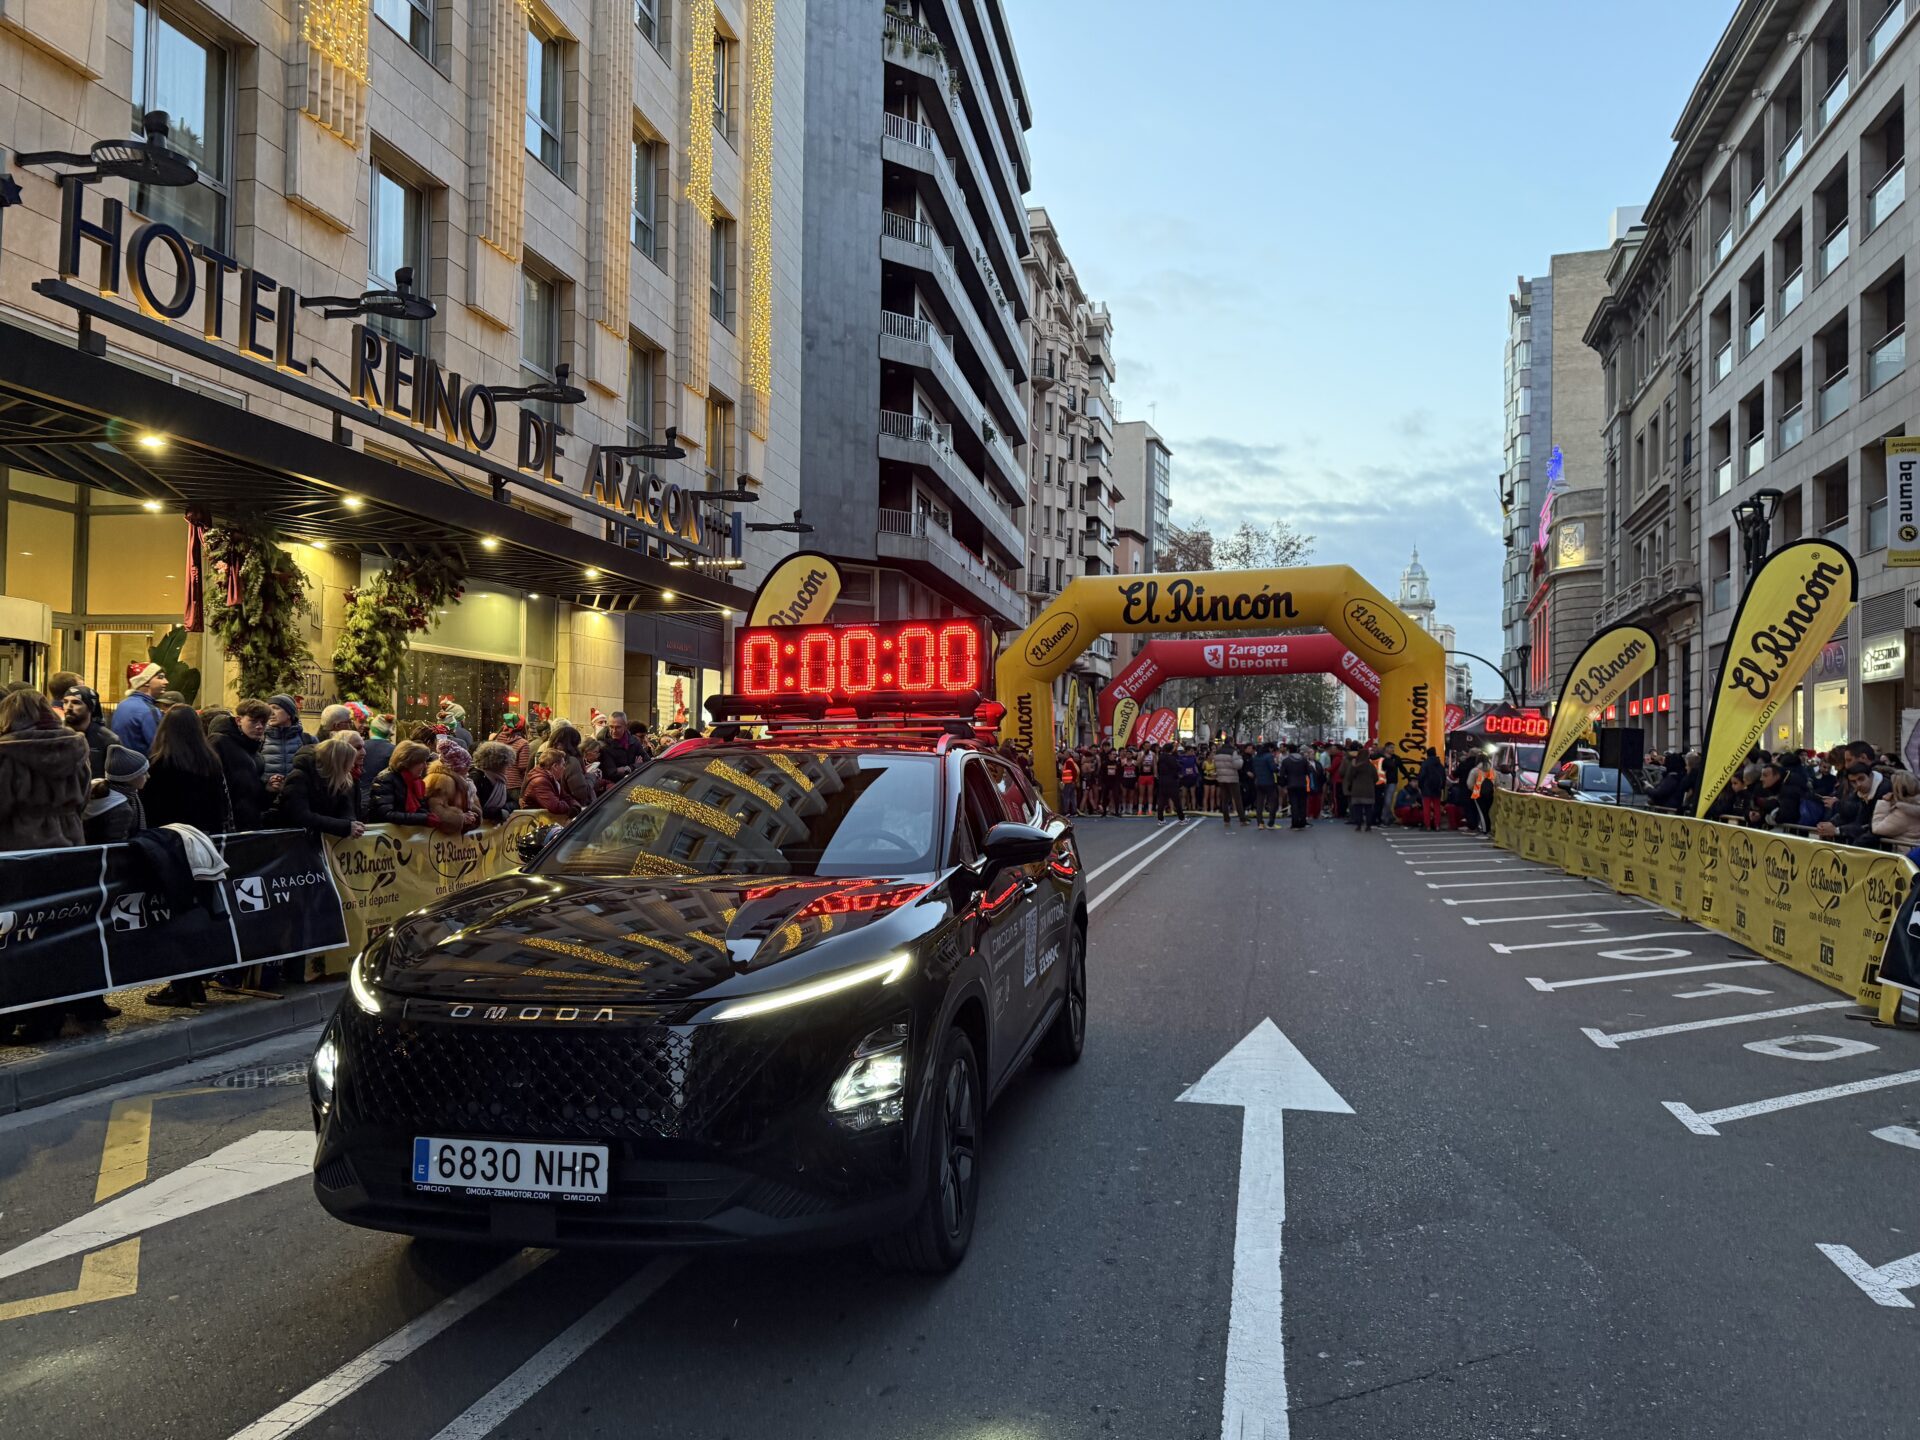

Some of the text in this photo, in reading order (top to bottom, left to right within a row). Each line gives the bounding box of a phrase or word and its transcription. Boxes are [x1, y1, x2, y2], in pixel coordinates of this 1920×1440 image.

[58, 177, 308, 376] HOTEL
[351, 323, 497, 452] REINO
[518, 408, 566, 485] DE
[1899, 460, 1917, 522] aumaq
[1118, 578, 1299, 625] El Rincón
[1350, 603, 1395, 650] El Rincón
[1728, 560, 1844, 700] El Rincón
[1030, 621, 1074, 662] El Rincón
[1229, 644, 1288, 657] Zaragoza
[743, 624, 978, 696] 0:00:00
[1123, 658, 1152, 687] Zaragoza
[1229, 656, 1288, 669] DEPORTE
[1356, 660, 1381, 685] Zarago
[1571, 639, 1647, 705] El Rincón
[1129, 665, 1160, 694] DEPORTE
[1486, 715, 1548, 737] 0:00:00
[1704, 699, 1779, 802] www.fselrincon.com
[336, 849, 395, 876] El Rincón
[434, 842, 446, 864] El
[446, 839, 478, 863] Rincón
[271, 870, 327, 889] ARAGÓN
[273, 891, 291, 905] TV
[359, 896, 367, 908] el
[369, 892, 400, 908] deporte
[24, 902, 93, 926] ARAGÓN
[152, 909, 171, 922] TV
[1824, 914, 1841, 928] deporte
[17, 926, 39, 942] TV
[418, 1165, 425, 1174] E
[438, 1144, 600, 1189] 6830 NHR
[465, 1187, 550, 1200] OMODA-ZENMOTOR.COM
